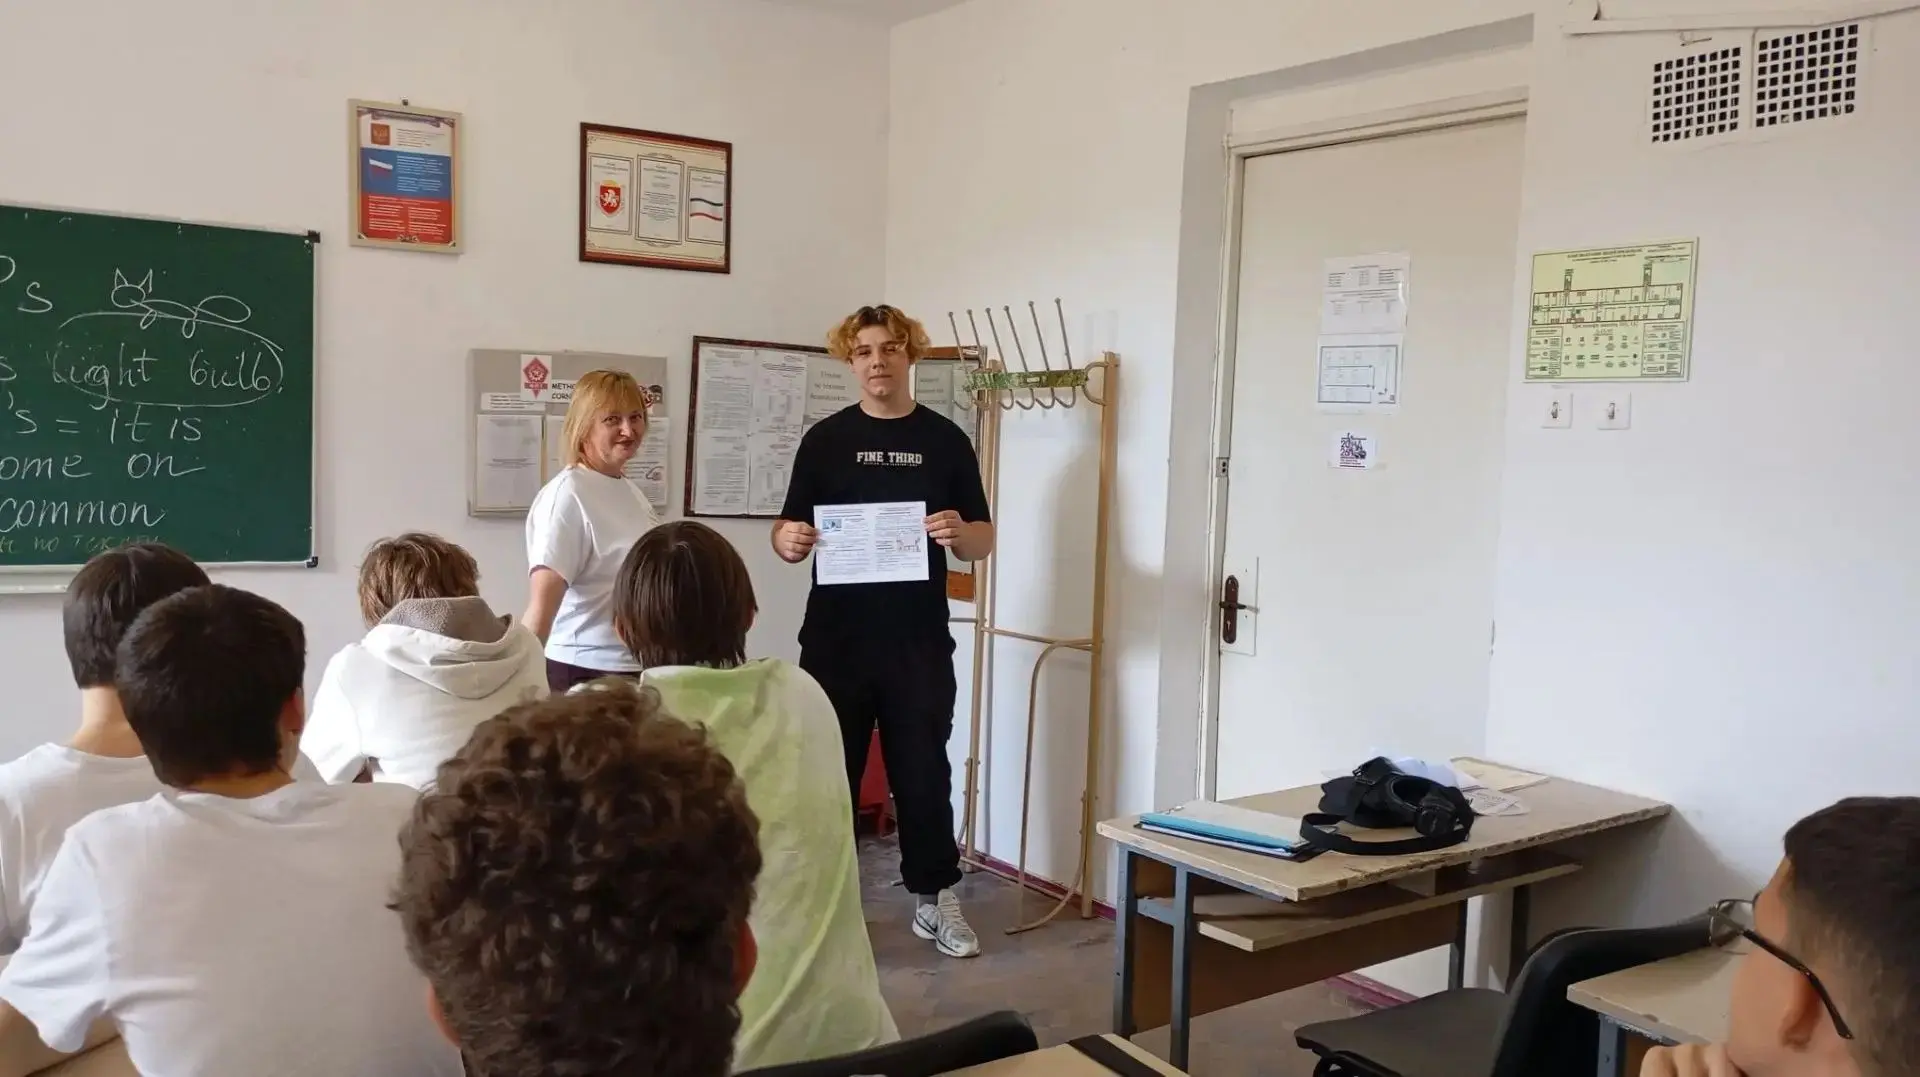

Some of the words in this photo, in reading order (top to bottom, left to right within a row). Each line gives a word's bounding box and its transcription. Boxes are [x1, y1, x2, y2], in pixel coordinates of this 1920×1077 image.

[110, 404, 152, 444] it
[169, 406, 203, 442] is
[127, 452, 206, 480] on
[856, 451, 884, 463] FINE
[888, 451, 923, 464] THIRD
[0, 497, 167, 533] common
